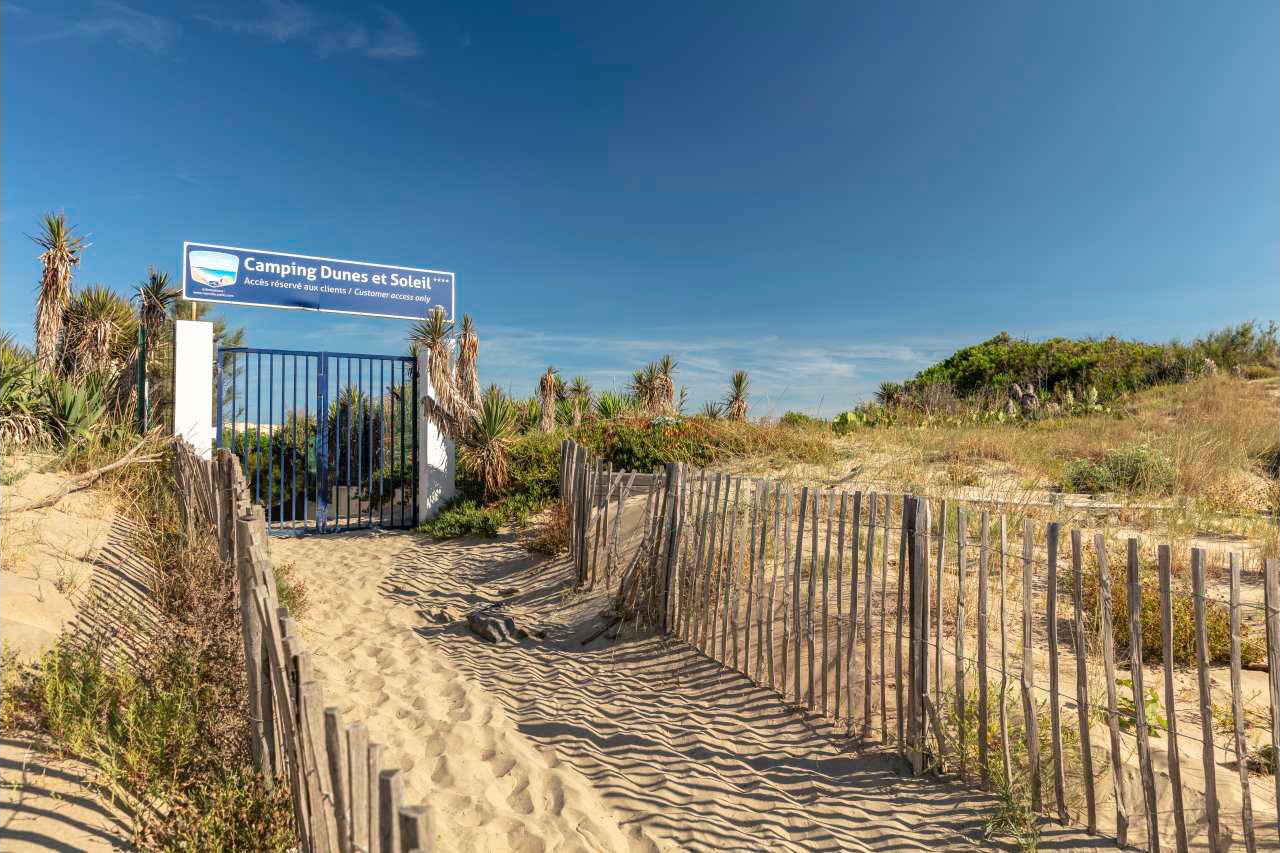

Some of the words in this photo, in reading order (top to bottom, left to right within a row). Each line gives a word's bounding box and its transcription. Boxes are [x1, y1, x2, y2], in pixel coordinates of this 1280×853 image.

[244, 257, 317, 280] Camping
[321, 265, 368, 283] Dunes
[372, 273, 387, 285] et
[391, 273, 432, 289] Soleil
[244, 277, 269, 287] Accès
[271, 279, 302, 290] réservé
[320, 284, 347, 294] clients
[354, 288, 389, 298] Customer
[391, 293, 413, 301] access
[415, 294, 431, 304] only
